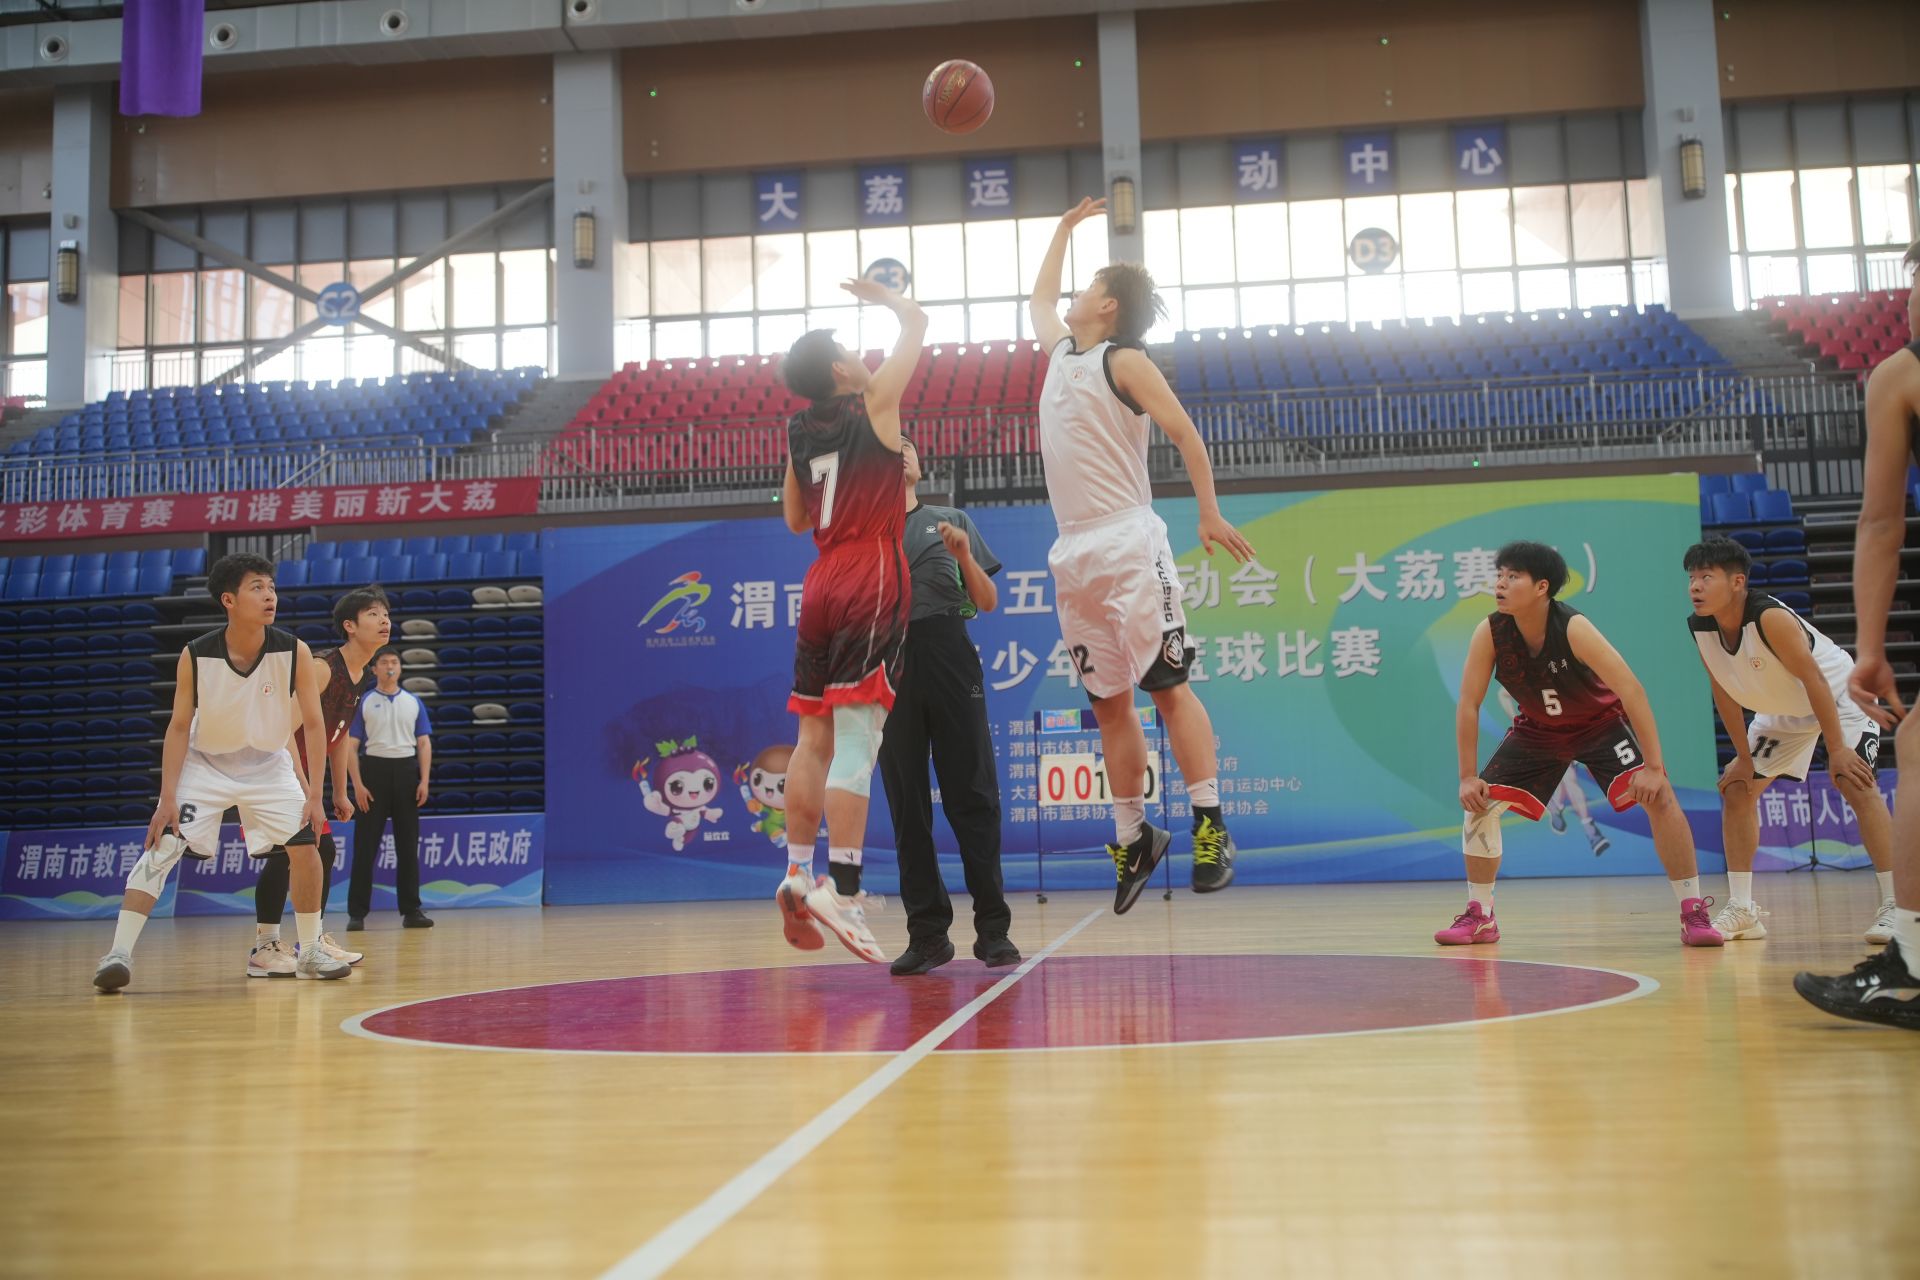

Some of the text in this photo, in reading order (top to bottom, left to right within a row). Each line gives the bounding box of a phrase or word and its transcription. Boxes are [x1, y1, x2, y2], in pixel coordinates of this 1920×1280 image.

[1354, 236, 1394, 264] D3
[318, 290, 357, 318] C2
[204, 481, 498, 525] 和谐美丽新大荔
[809, 451, 839, 529] 7
[1541, 688, 1563, 716] 5
[1613, 739, 1636, 766] 5
[1751, 735, 1780, 758] 11
[179, 803, 197, 824] 6
[378, 829, 532, 870] 渭市人民政府
